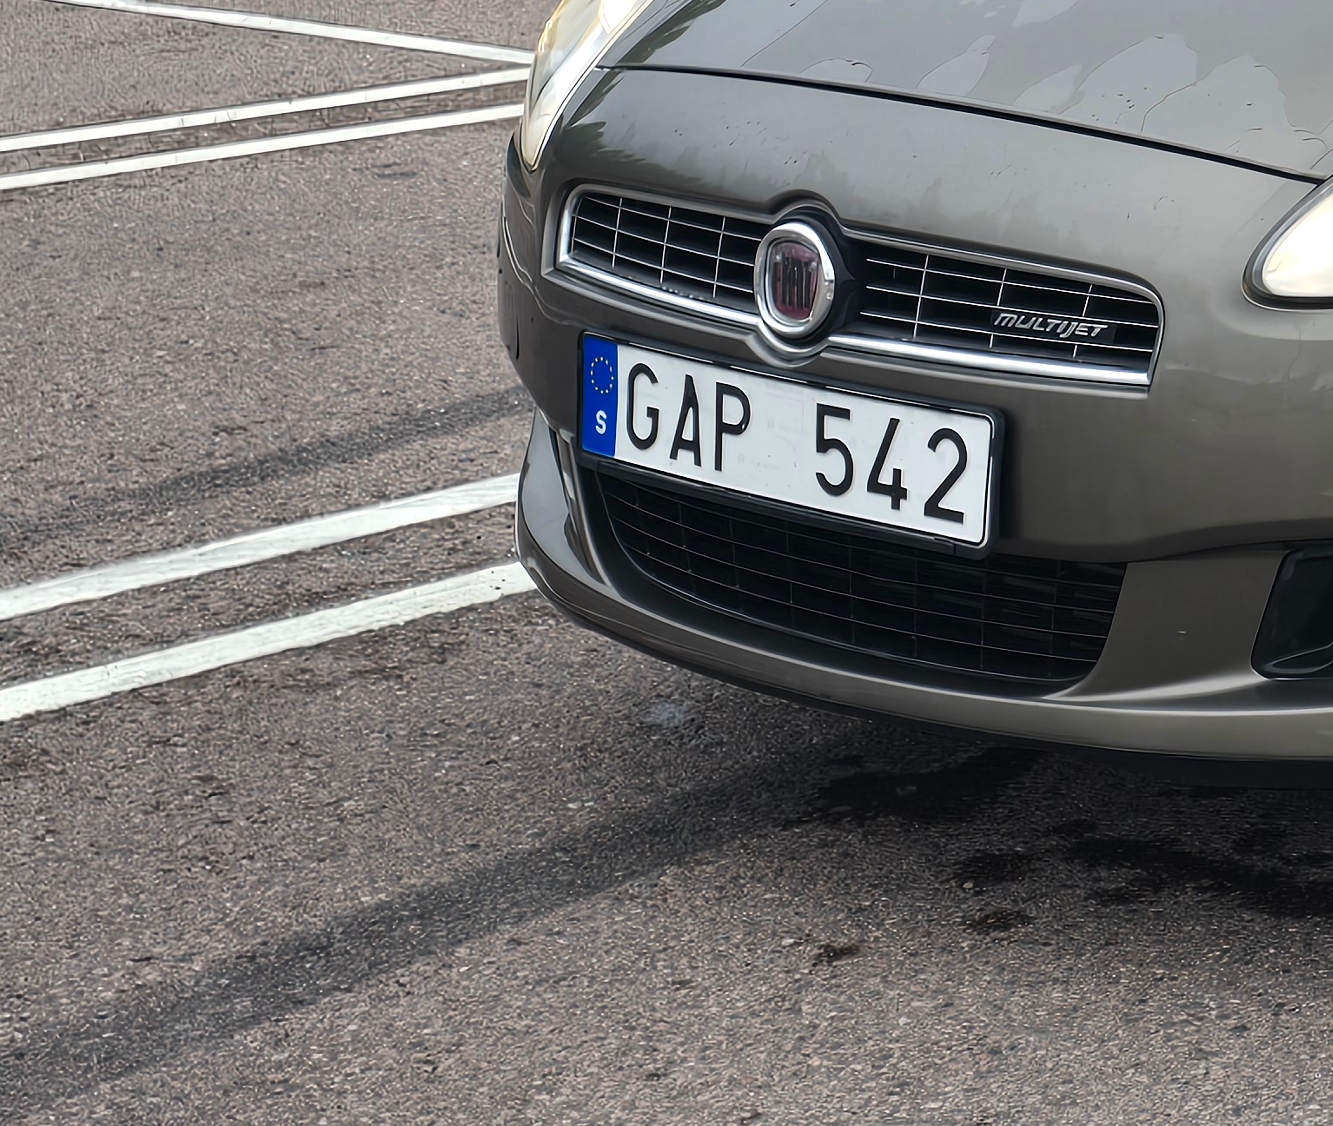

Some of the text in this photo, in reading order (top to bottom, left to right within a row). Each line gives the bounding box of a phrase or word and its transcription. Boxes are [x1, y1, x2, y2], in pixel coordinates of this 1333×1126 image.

[994, 313, 1108, 338] MULTIJET
[595, 410, 607, 435] S
[626, 362, 968, 525] GAP 542
